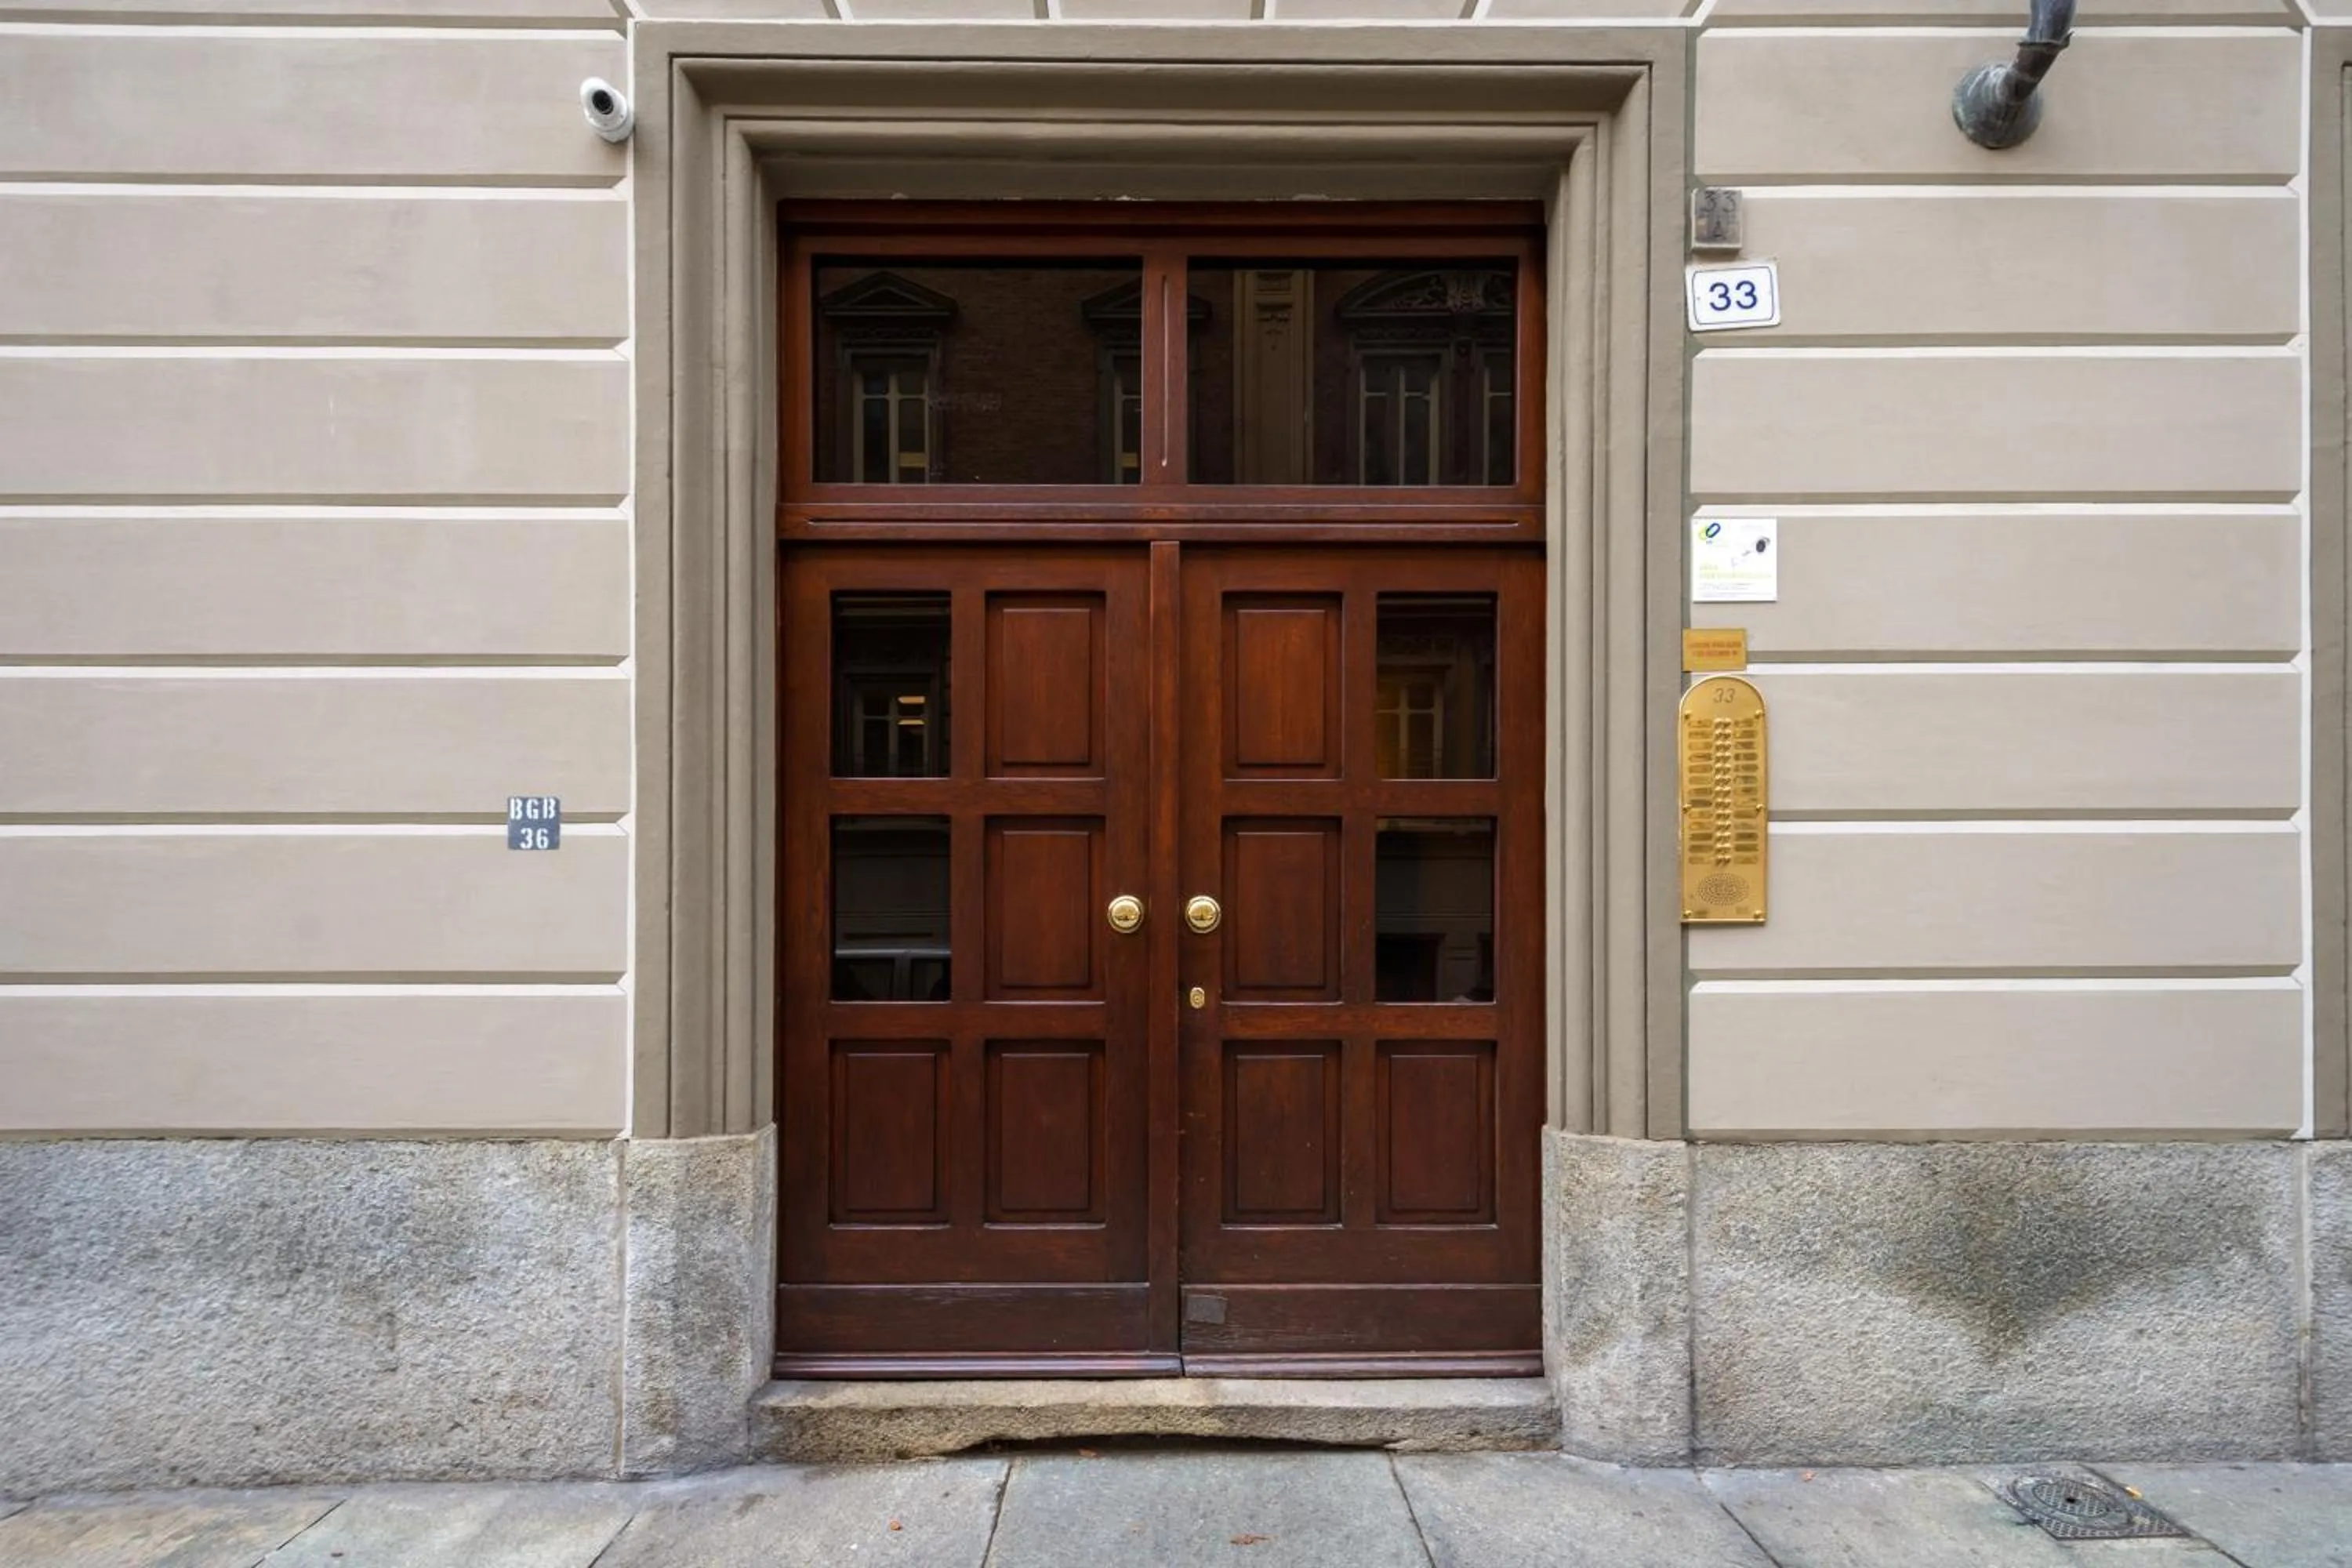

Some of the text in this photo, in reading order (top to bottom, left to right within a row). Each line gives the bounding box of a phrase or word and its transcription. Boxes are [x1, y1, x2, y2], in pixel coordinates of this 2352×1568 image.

[1709, 280, 1758, 311] 33
[1713, 688, 1736, 703] 33
[510, 797, 556, 820] BGB
[520, 827, 550, 850] 36
